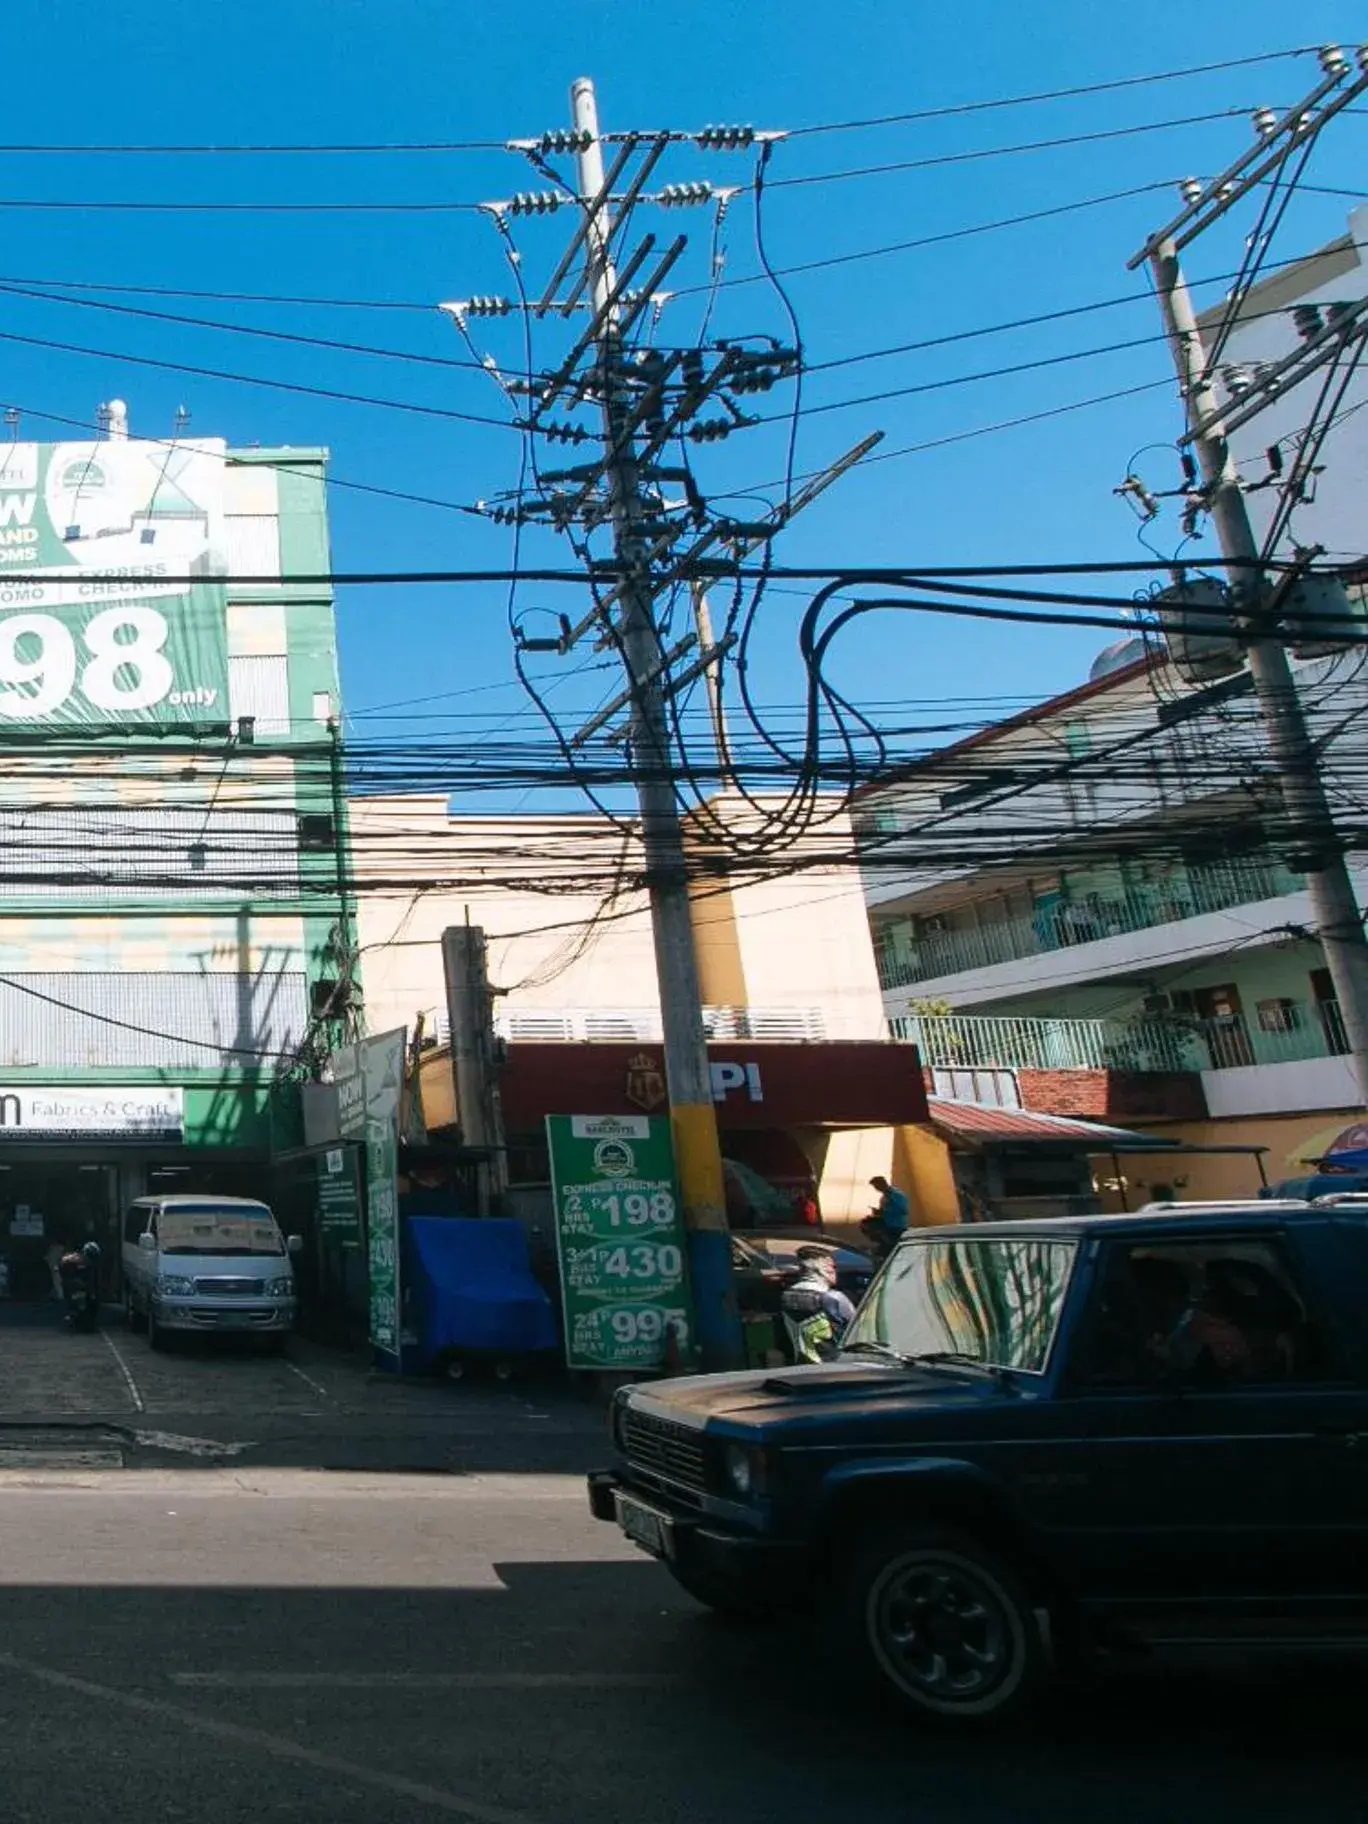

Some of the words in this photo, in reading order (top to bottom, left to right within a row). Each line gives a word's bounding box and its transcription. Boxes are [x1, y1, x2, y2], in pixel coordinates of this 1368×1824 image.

[168, 686, 217, 706] only
[709, 1062, 763, 1102] PI
[601, 1193, 678, 1227] 198
[604, 1244, 682, 1280] 430
